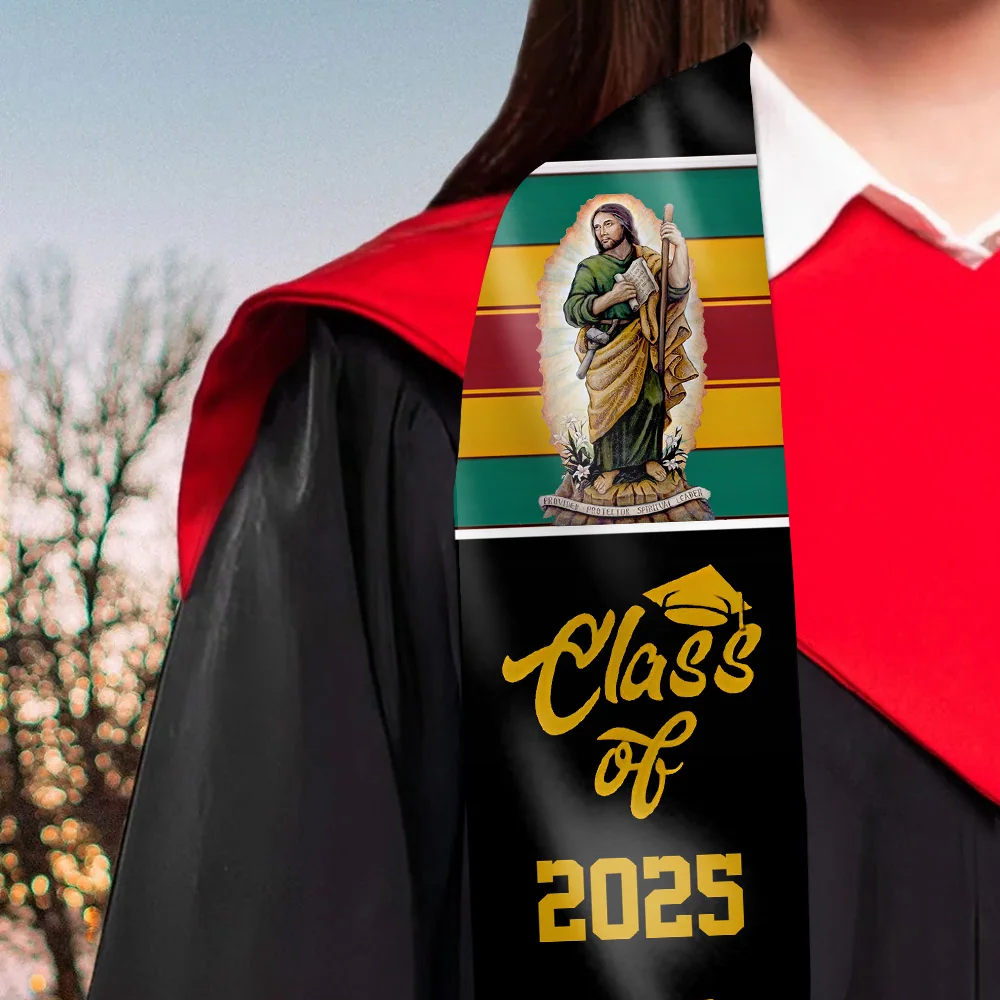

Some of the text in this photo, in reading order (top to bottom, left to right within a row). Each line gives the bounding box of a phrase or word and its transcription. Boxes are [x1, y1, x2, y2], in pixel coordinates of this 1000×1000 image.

[586, 505, 630, 516] PROTECTOR
[676, 488, 704, 503] LEADER
[502, 605, 762, 736] Class
[594, 711, 697, 820] of
[536, 853, 745, 943] 2025
